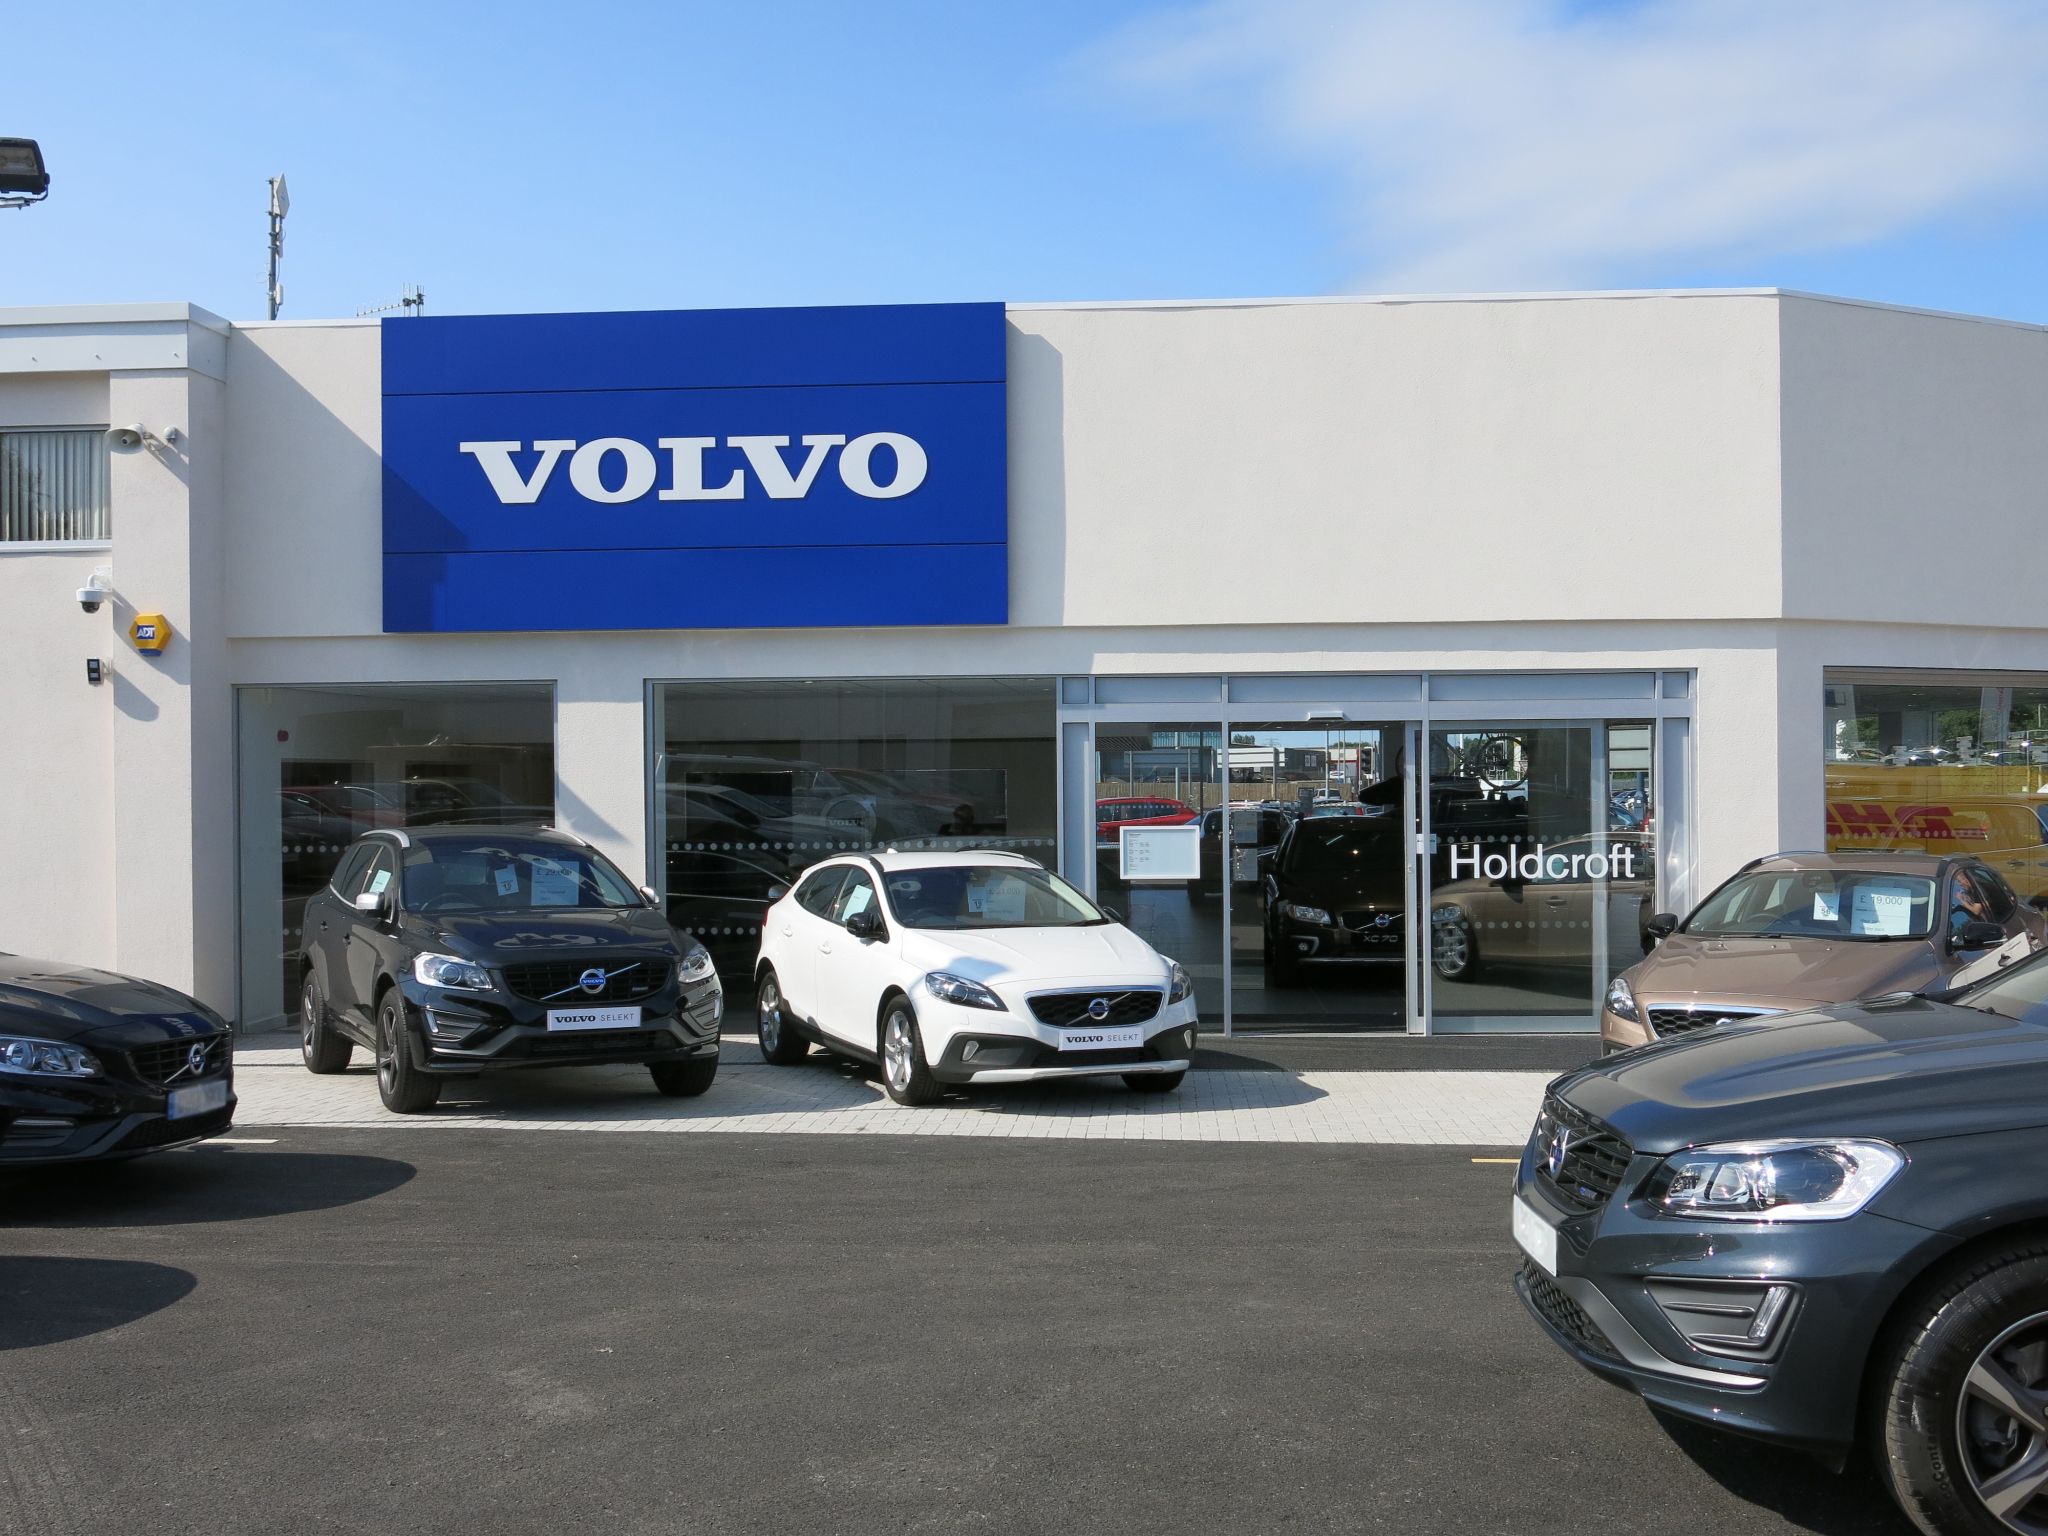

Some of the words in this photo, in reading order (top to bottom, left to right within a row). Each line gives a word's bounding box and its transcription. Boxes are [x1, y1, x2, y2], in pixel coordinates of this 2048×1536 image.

[460, 432, 927, 503] VOLVO
[137, 627, 156, 637] ADT
[1451, 843, 1635, 879] Holdcroft
[555, 1015, 596, 1023] VOLVO
[601, 1013, 634, 1021] SELEKT
[1066, 1035, 1103, 1043] VOLVO
